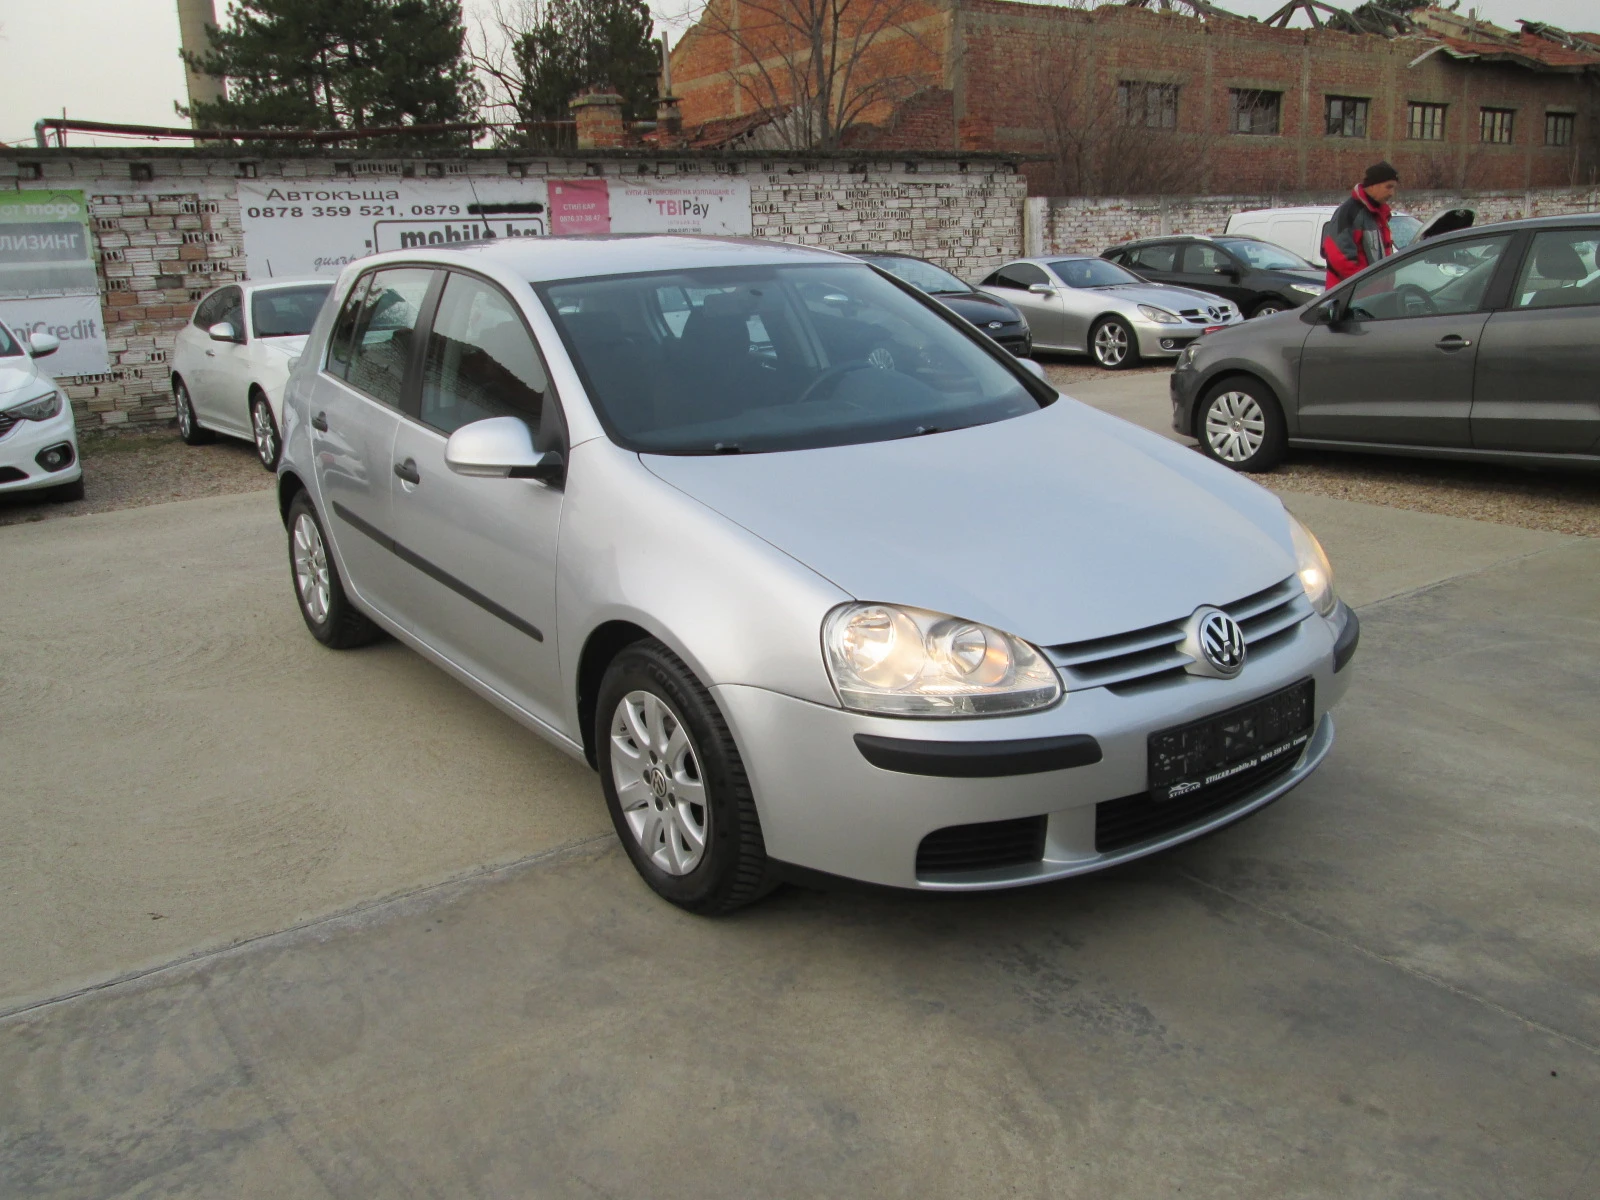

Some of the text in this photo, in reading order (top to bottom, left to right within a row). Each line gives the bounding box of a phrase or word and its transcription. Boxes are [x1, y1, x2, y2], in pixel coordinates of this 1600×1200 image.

[266, 188, 399, 202] Автокъща
[24, 203, 80, 220] mogo
[247, 207, 303, 218] 0878
[312, 206, 351, 217] 359
[411, 205, 460, 216] 0879
[656, 199, 709, 219] TBIPay
[0, 234, 79, 251] ЛИЗИНГ
[9, 319, 97, 343] niCredit
